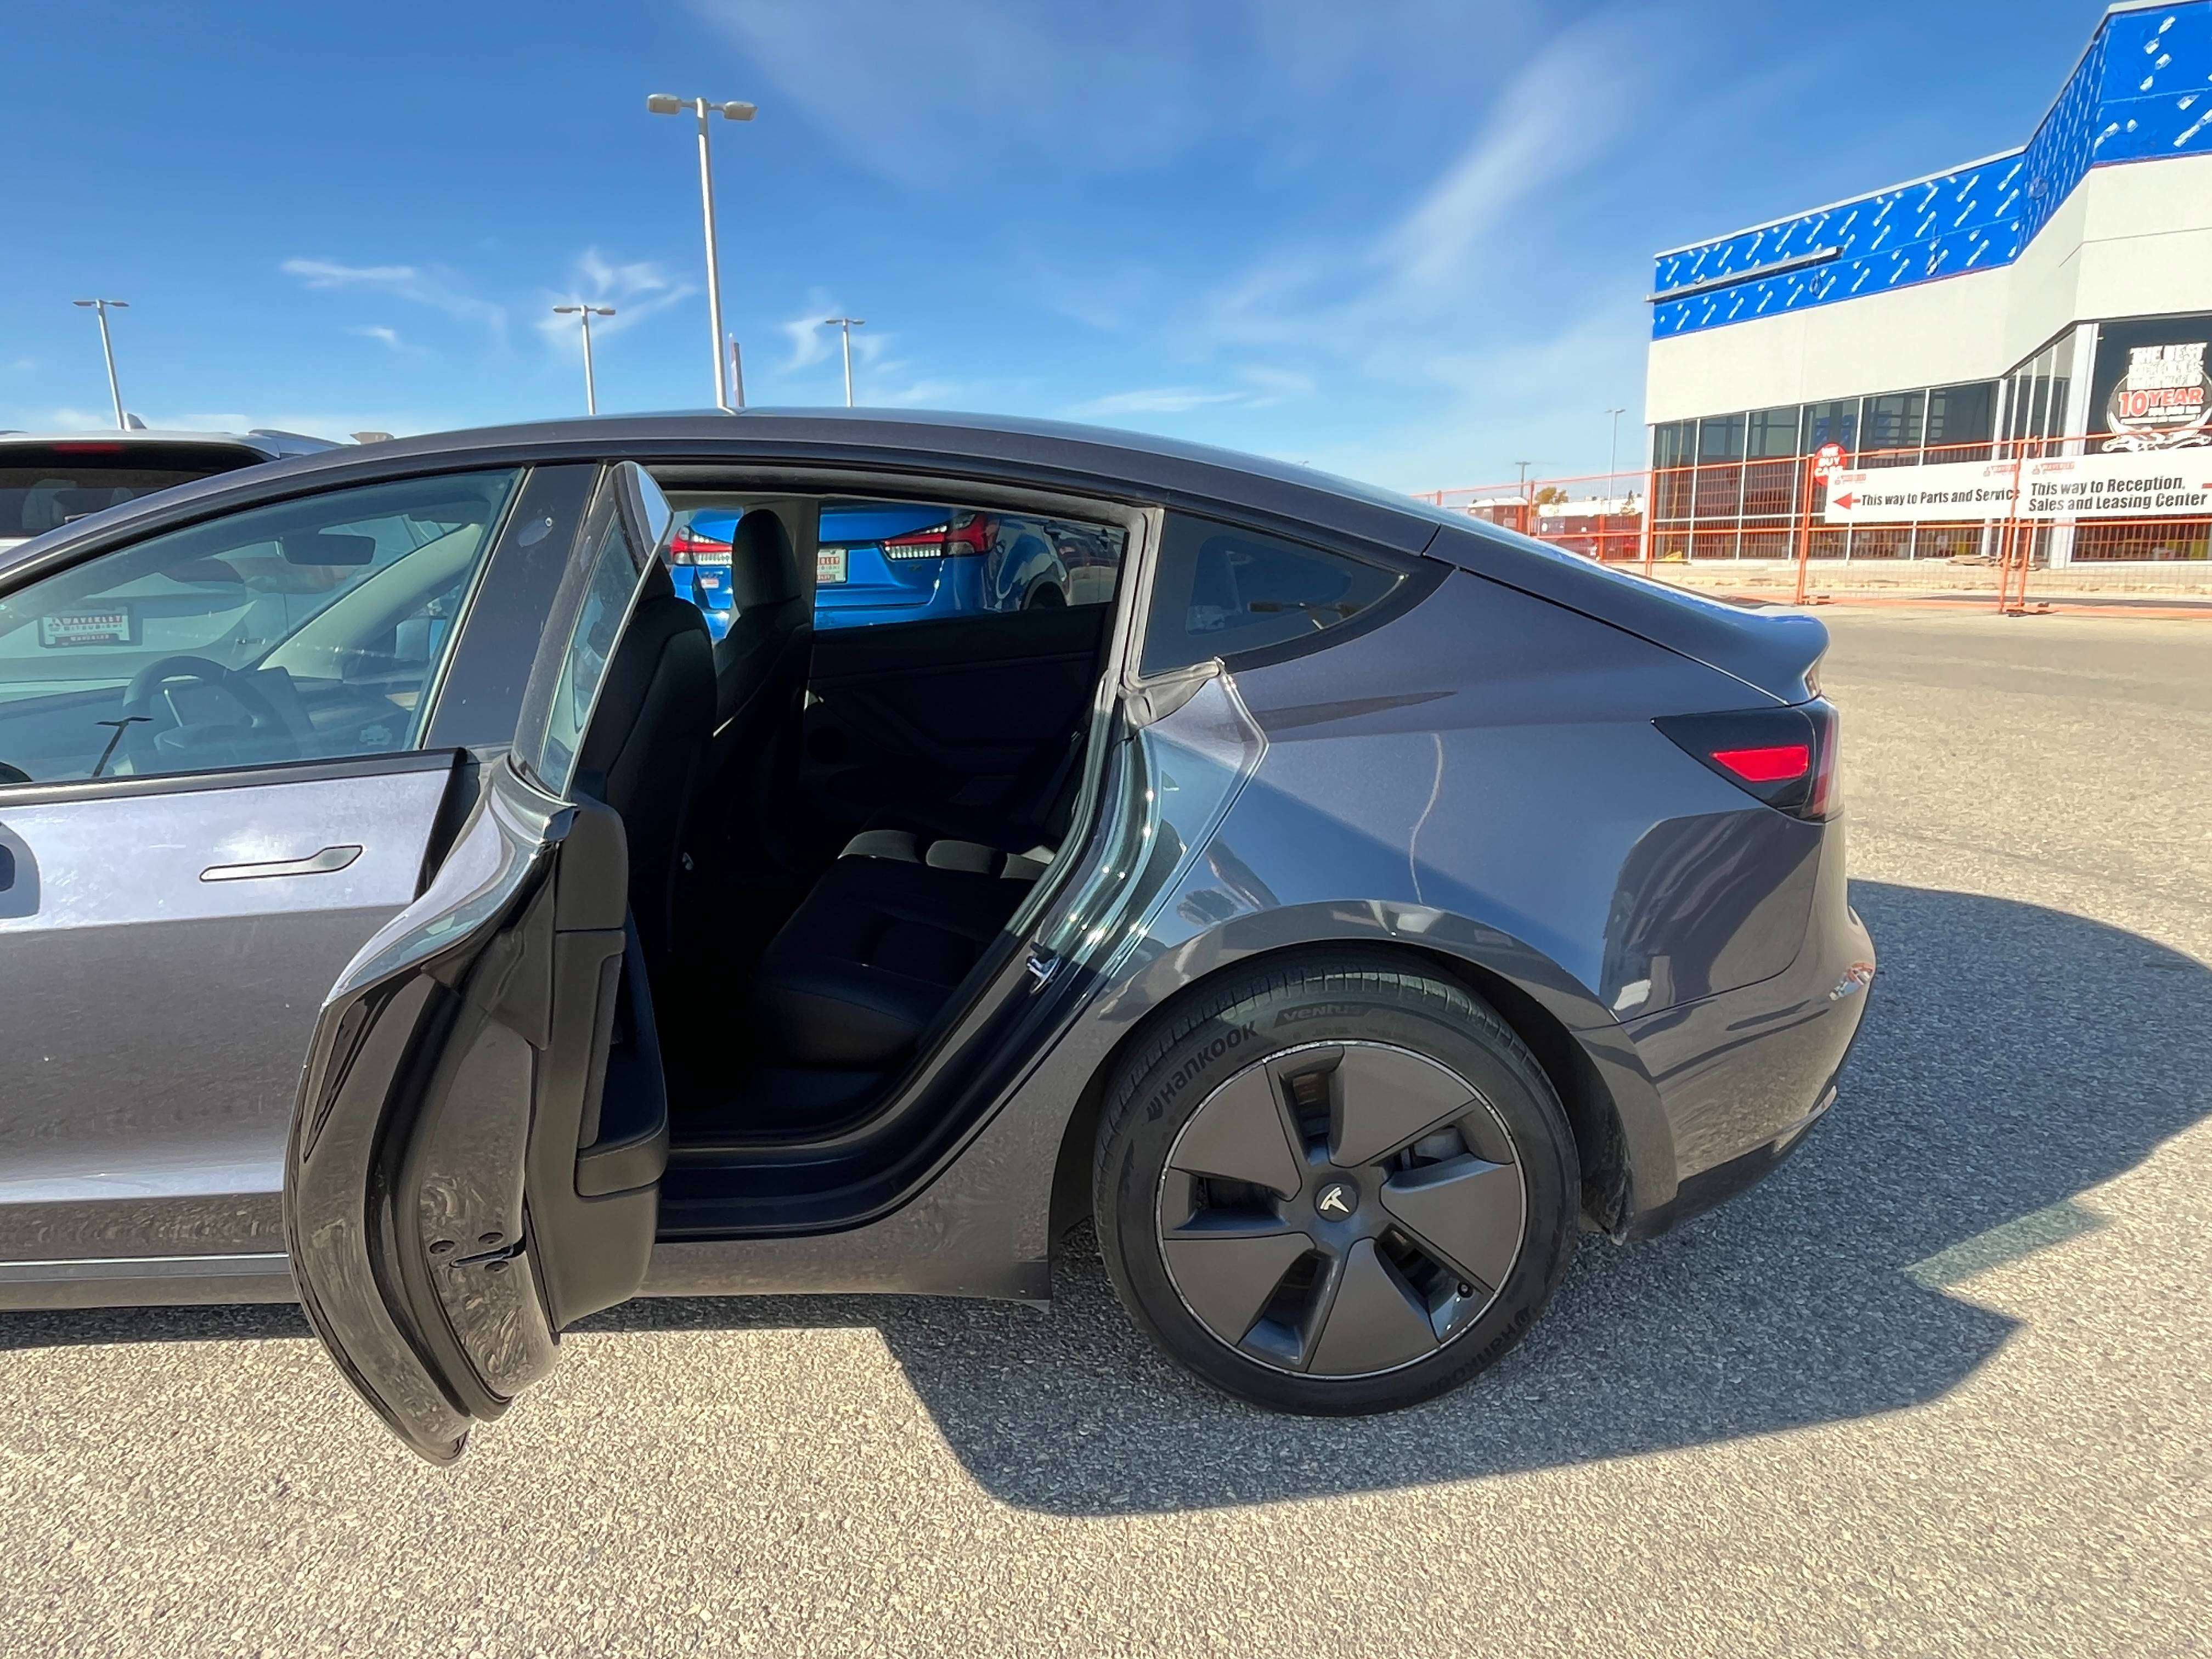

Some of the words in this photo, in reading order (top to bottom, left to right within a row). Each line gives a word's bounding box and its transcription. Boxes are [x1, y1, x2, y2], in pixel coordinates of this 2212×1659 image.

[2118, 390, 2148, 417] 10
[2147, 387, 2204, 407] YEAR
[2031, 482, 2057, 495] This
[2061, 483, 2088, 495] way
[2090, 481, 2103, 493] to
[1862, 494, 1883, 506] This
[1885, 495, 1905, 506] way
[1907, 493, 1918, 505] to
[1920, 492, 1949, 504] Parts
[1951, 490, 1973, 502] and
[2029, 498, 2064, 511] Sales
[2067, 496, 2093, 510] and
[2096, 495, 2152, 509] Leasing
[2155, 493, 2208, 507] Center
